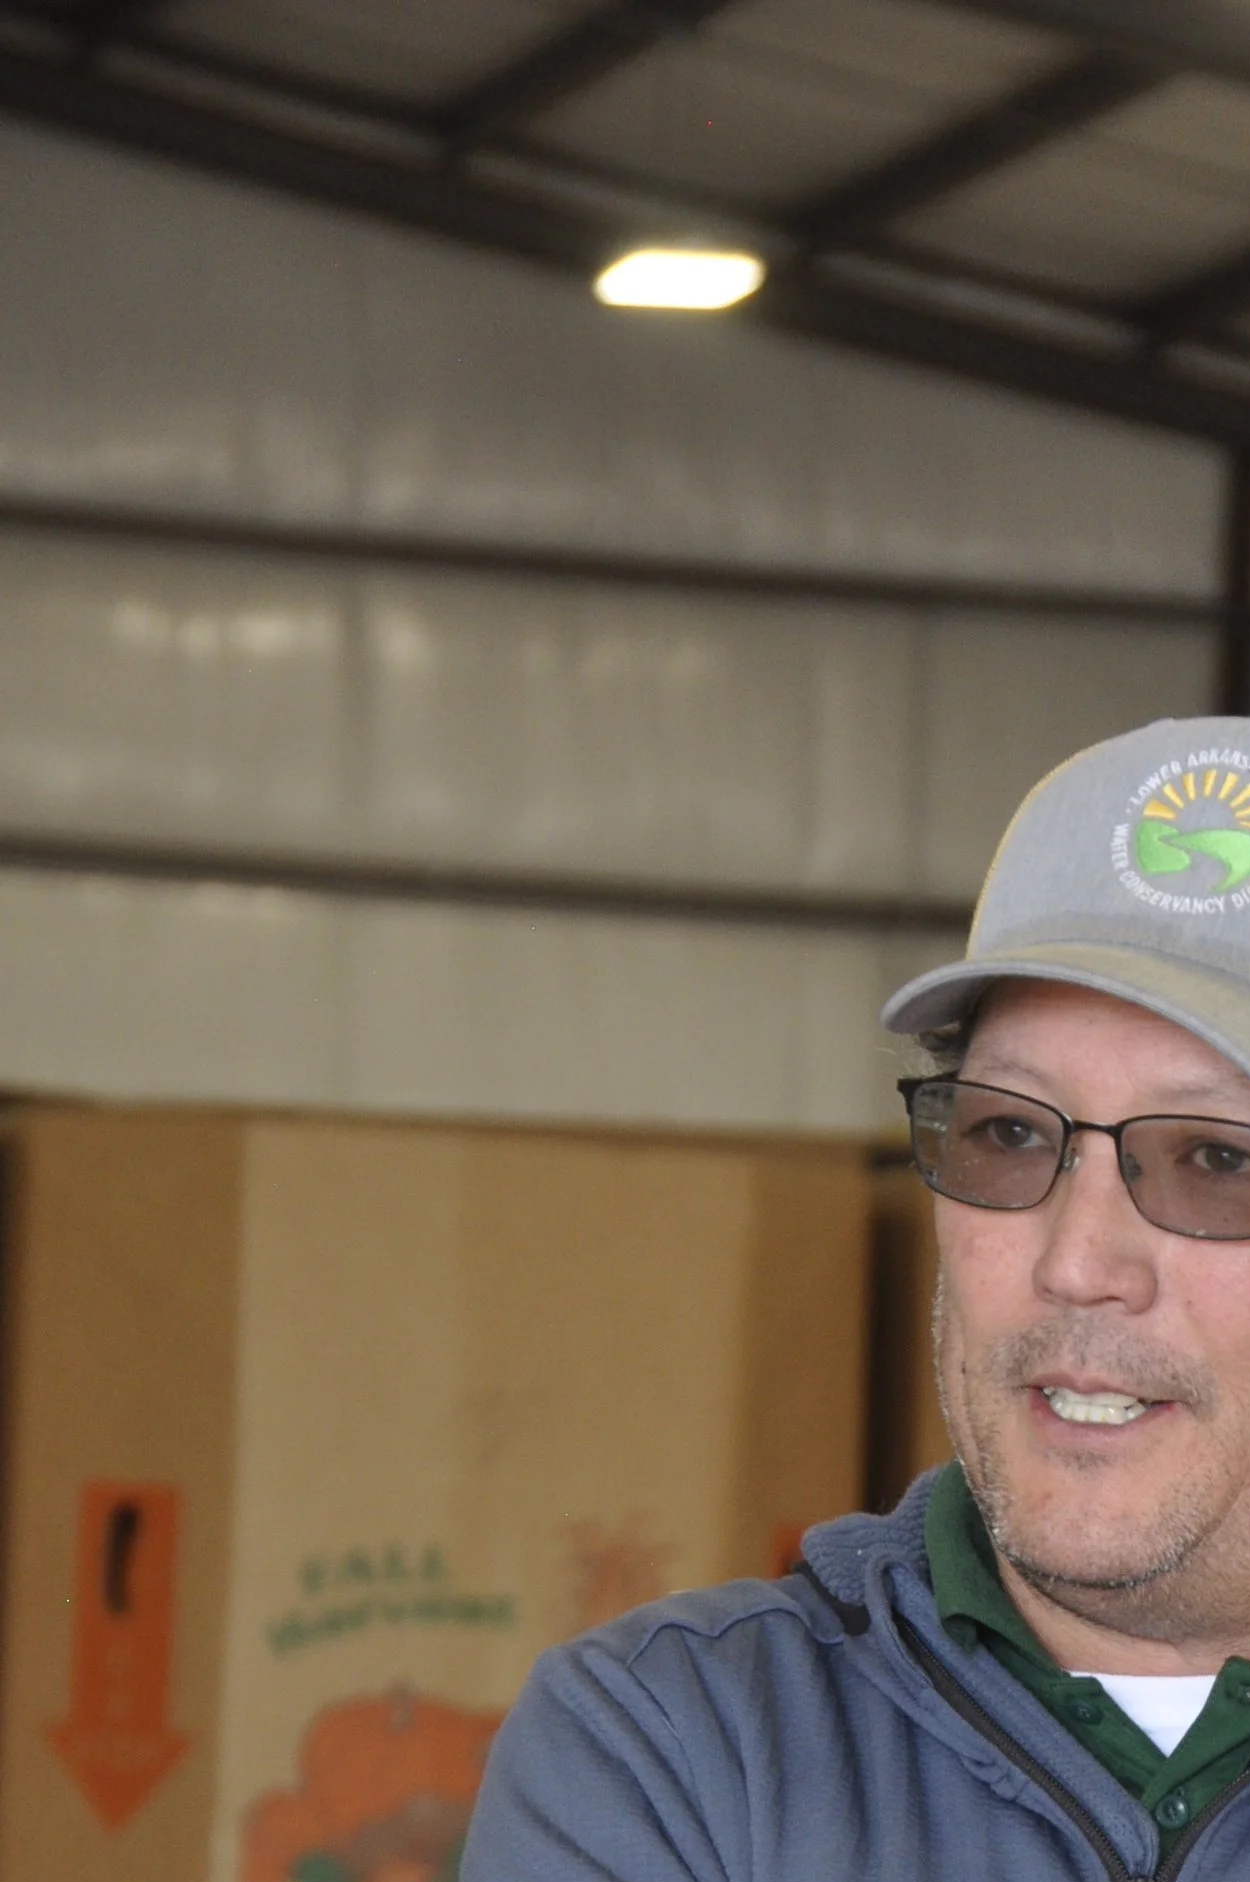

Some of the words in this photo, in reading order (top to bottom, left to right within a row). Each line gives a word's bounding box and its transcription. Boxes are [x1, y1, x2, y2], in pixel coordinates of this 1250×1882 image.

[1129, 759, 1182, 805] LOWER
[1110, 822, 1130, 872] WATER
[1119, 871, 1225, 914] CONSERVANCY
